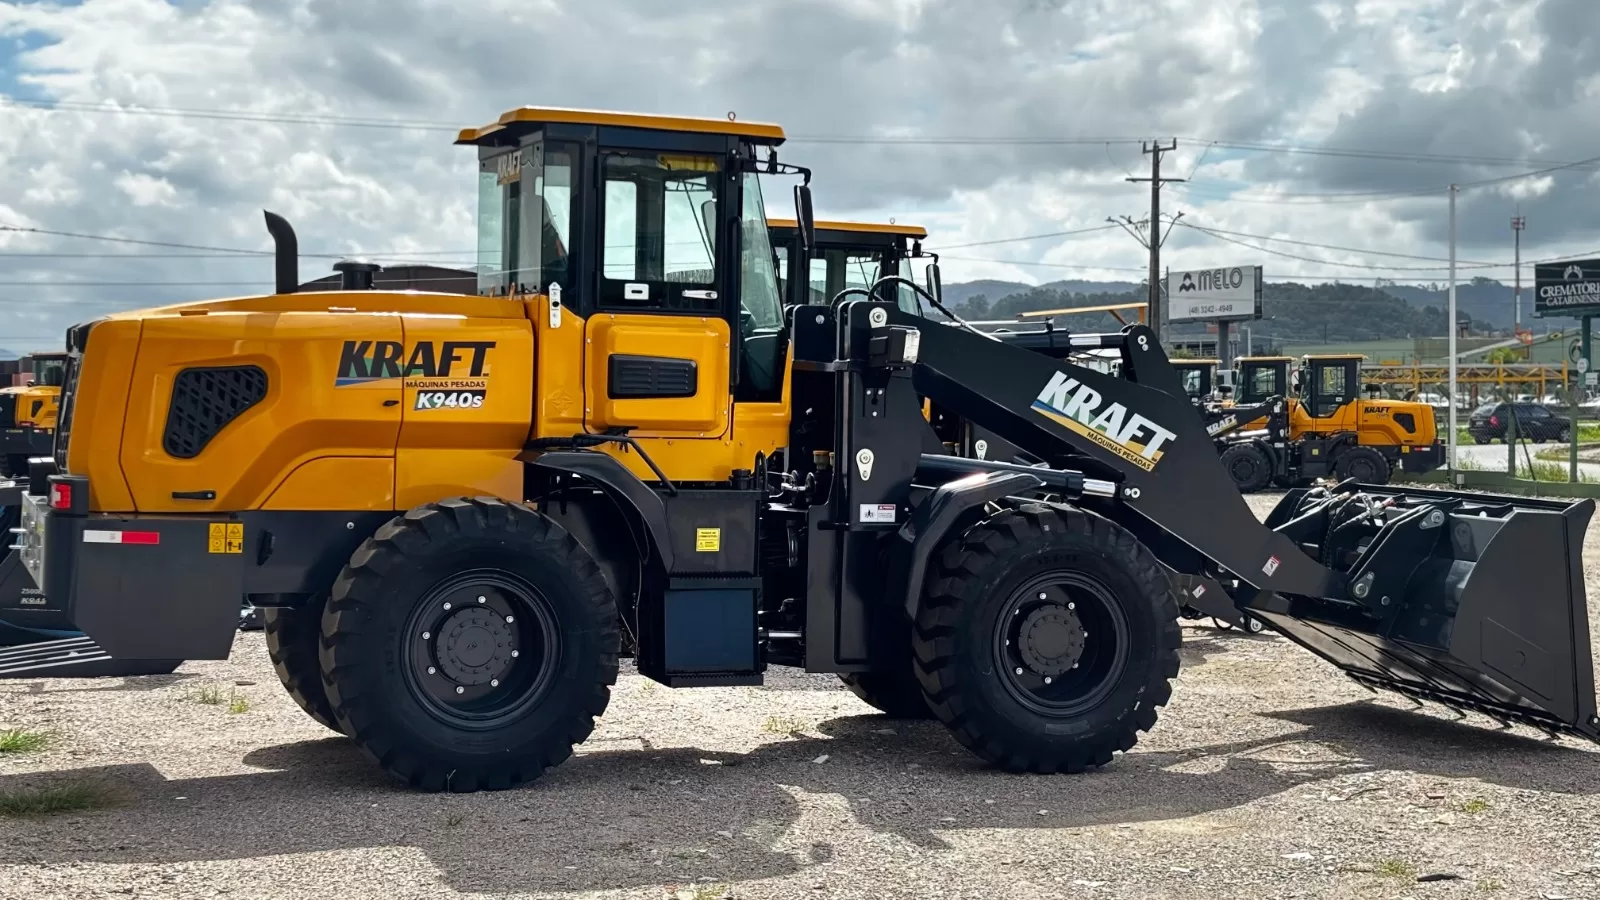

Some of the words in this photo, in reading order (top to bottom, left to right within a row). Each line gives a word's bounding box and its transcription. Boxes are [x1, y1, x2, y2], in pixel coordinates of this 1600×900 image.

[1198, 267, 1243, 291] MELO
[337, 341, 496, 377] KRAFT
[406, 380, 448, 388] MÁQUINAS
[417, 392, 483, 409] K940s
[1037, 370, 1177, 459] KRAFT
[1206, 414, 1236, 434] KRAFT
[1087, 431, 1122, 455] MÁQUINAS
[1122, 451, 1151, 470] PESADAS
